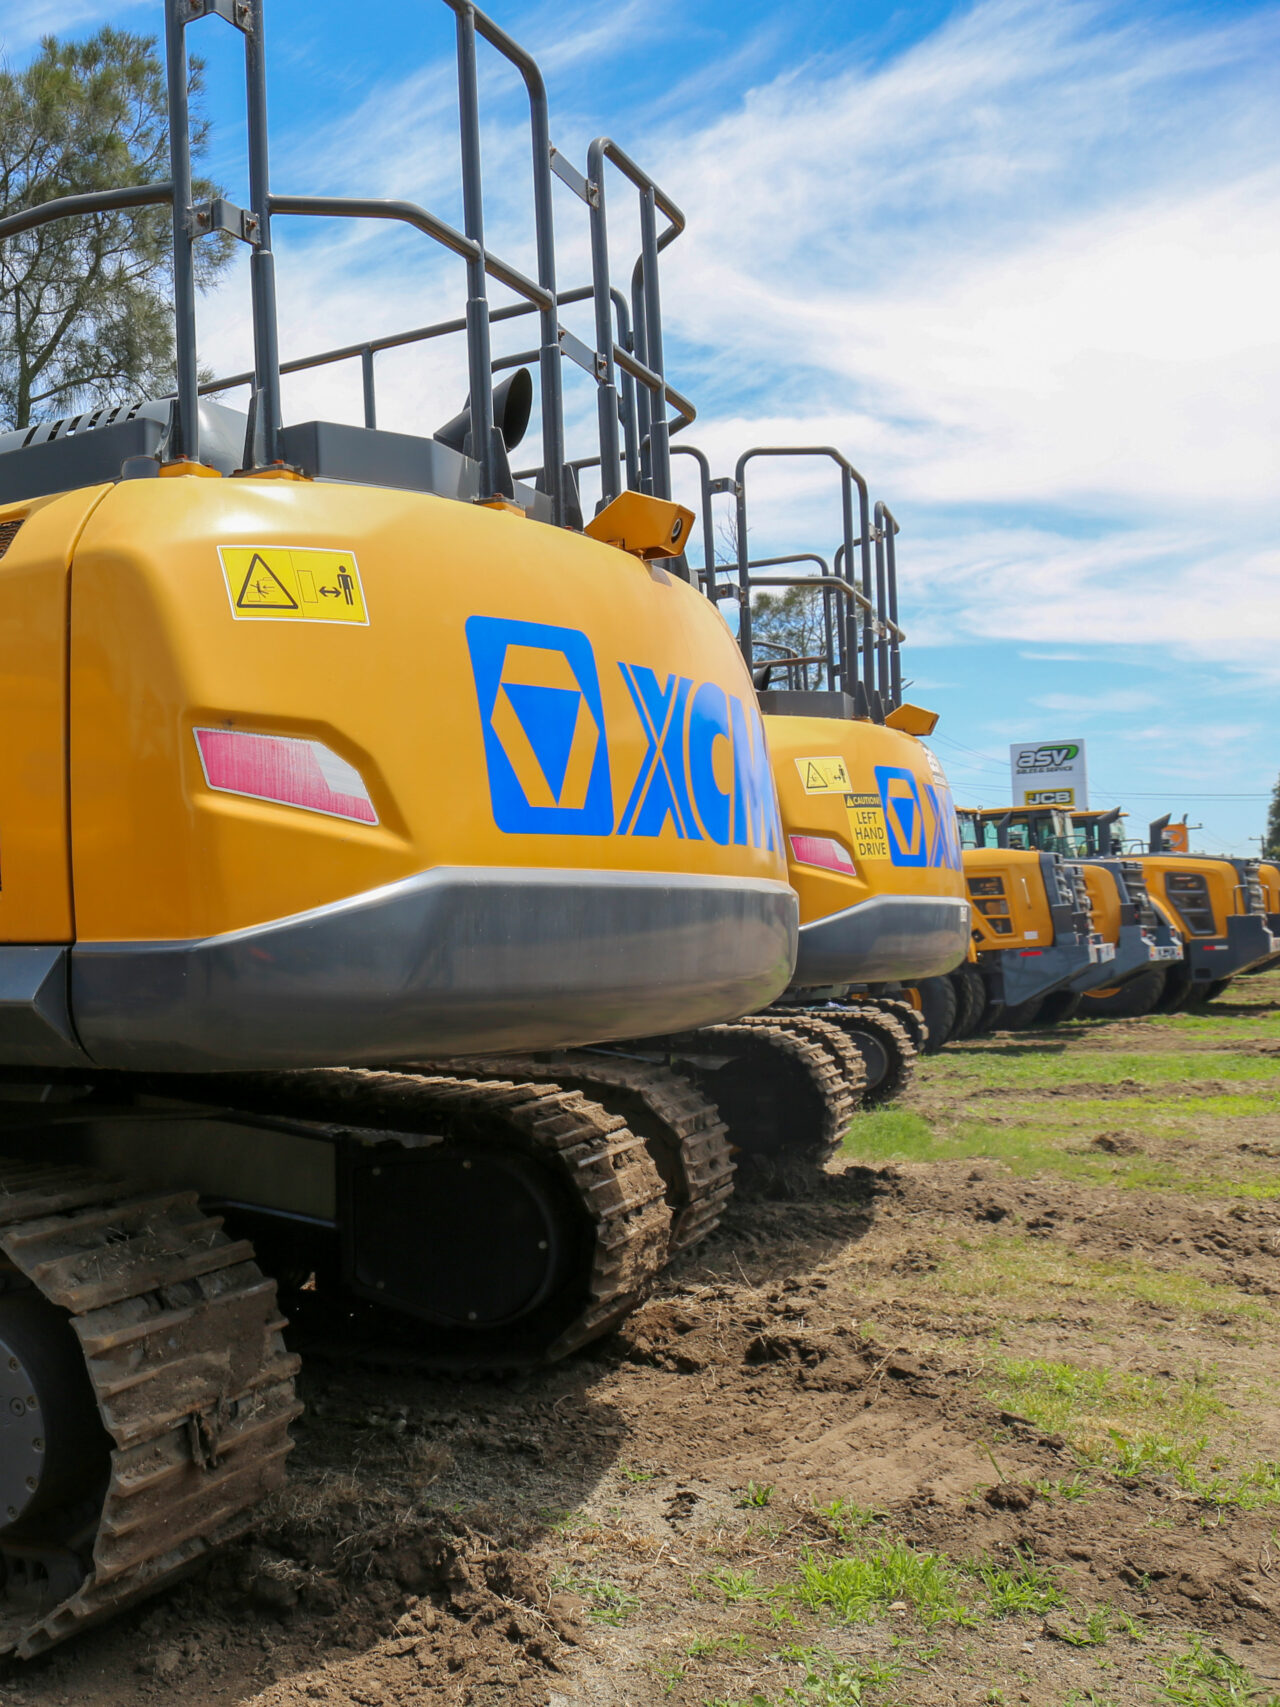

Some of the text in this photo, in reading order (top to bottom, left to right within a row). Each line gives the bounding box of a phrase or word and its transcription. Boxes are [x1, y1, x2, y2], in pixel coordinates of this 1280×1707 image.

[615, 660, 785, 860] XCM
[1028, 791, 1071, 805] JCB
[856, 811, 877, 824] LEFT
[855, 826, 884, 840] HAND
[859, 842, 887, 855] DRIVE
